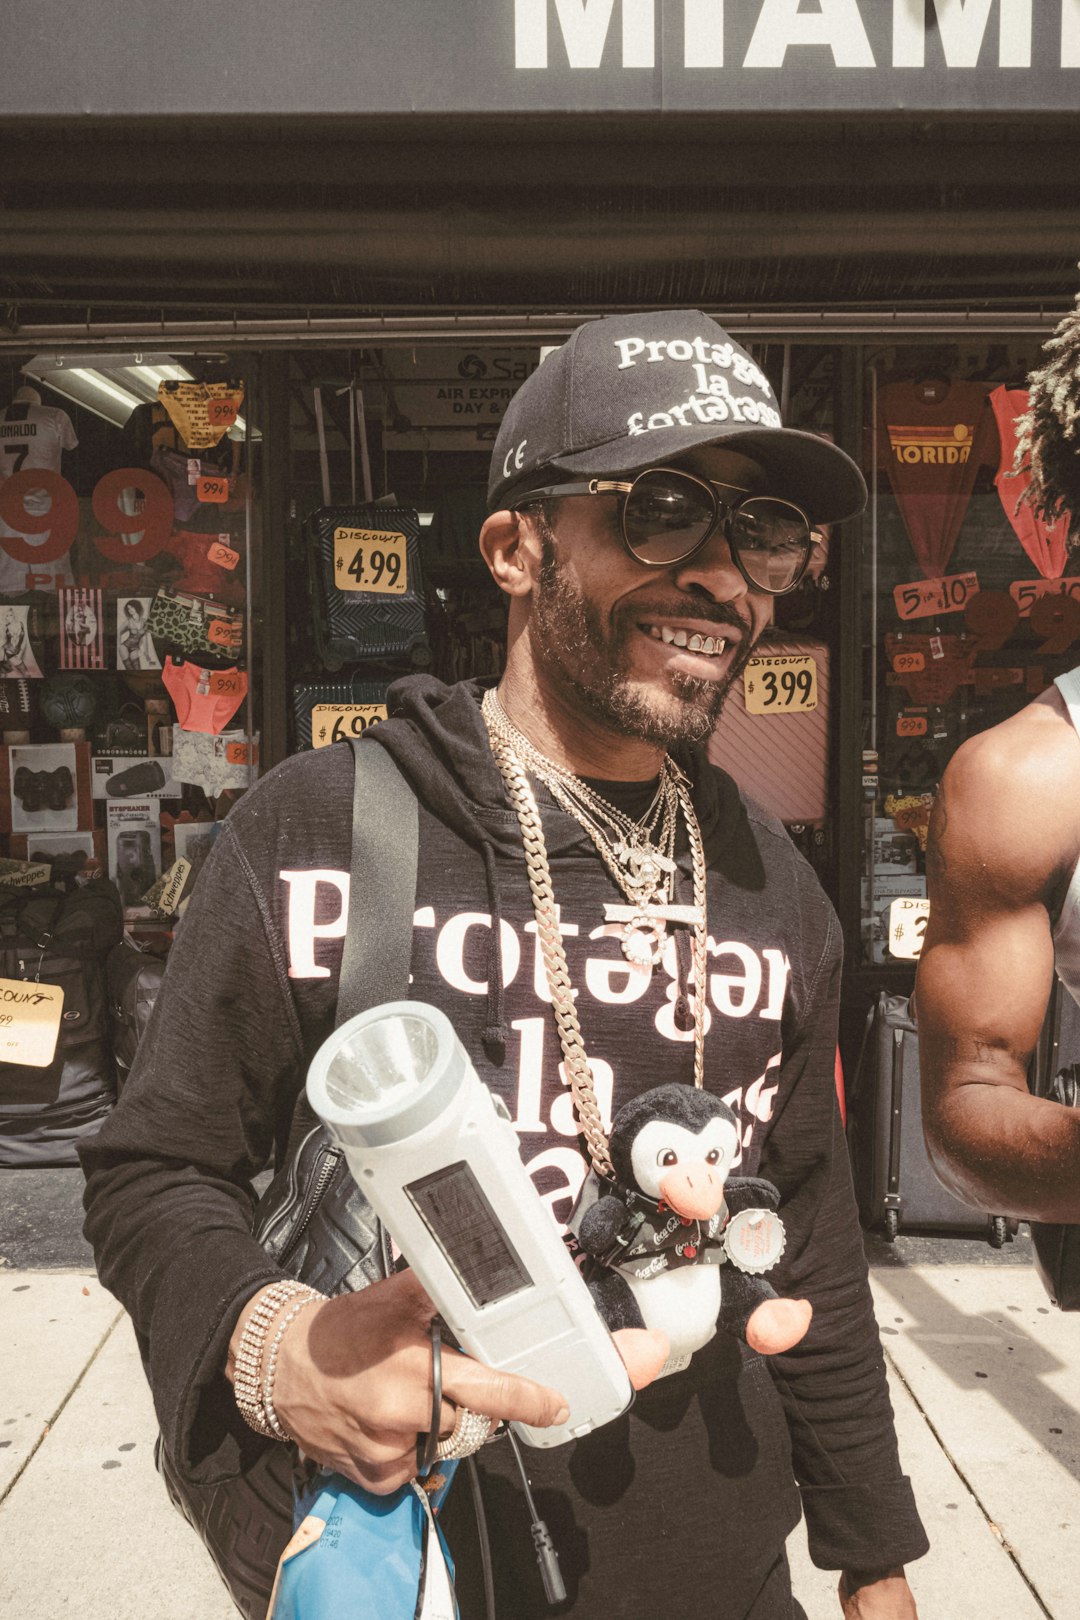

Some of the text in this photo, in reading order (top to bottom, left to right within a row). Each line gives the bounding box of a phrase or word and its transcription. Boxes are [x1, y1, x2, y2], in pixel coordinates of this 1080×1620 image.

[692, 363, 729, 398] la
[437, 388, 463, 399] AIR
[453, 403, 500, 414] DAY &
[4, 444, 29, 474] 7
[891, 445, 971, 465] LORIDA
[203, 481, 224, 495] 99¢
[336, 530, 404, 544] DISCOUNT
[336, 556, 344, 572] $
[347, 547, 402, 586] 4.99
[902, 588, 921, 615] 5
[748, 657, 811, 667] DISCOUNT
[748, 680, 755, 695] $
[762, 670, 813, 706] 3.99
[316, 705, 384, 713] DISCOUNT
[318, 725, 327, 741] $
[163, 862, 185, 909] Schweppes
[894, 923, 904, 941] $
[511, 1017, 613, 1137] la
